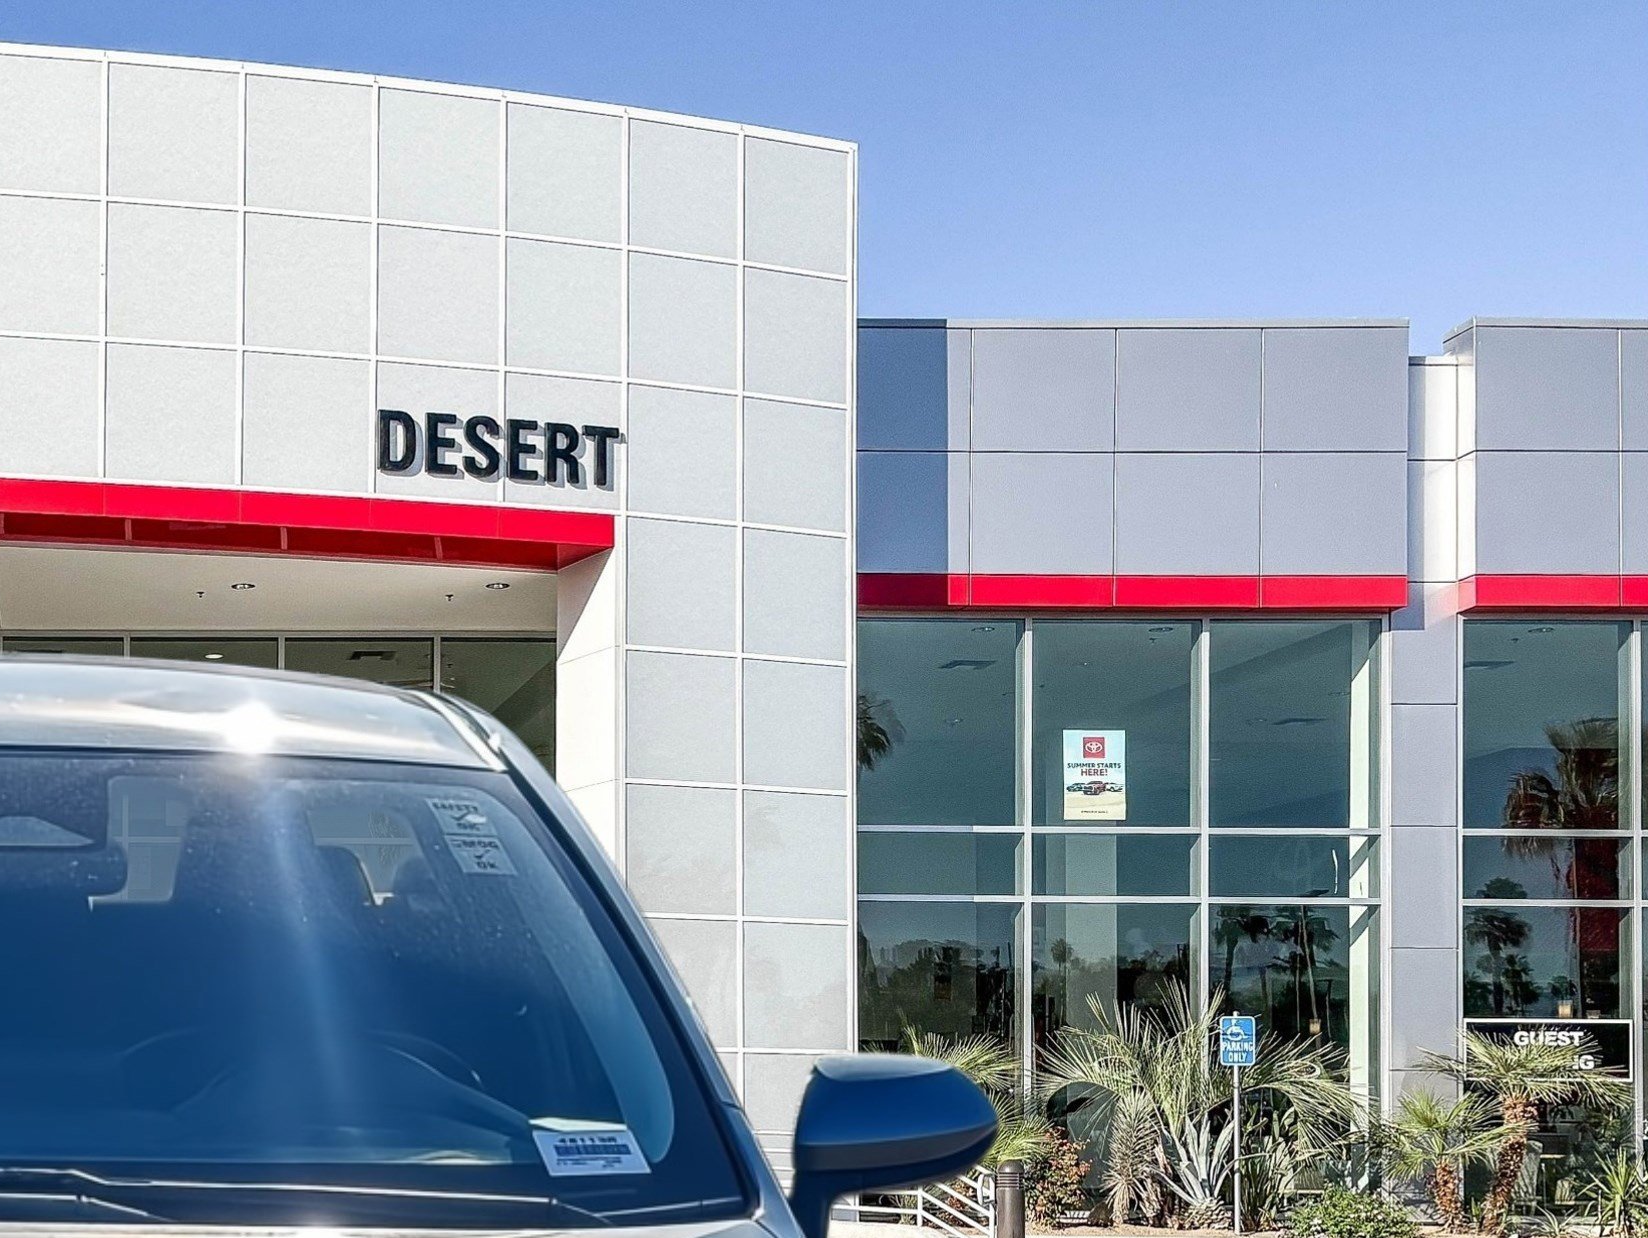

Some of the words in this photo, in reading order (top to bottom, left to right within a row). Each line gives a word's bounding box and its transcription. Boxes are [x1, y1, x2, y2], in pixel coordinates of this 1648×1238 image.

[377, 408, 621, 487] DESERT
[1080, 768, 1108, 777] HERE!
[1513, 1031, 1585, 1047] GUEST
[1222, 1041, 1254, 1052] PARKING
[1228, 1051, 1247, 1062] ONLY
